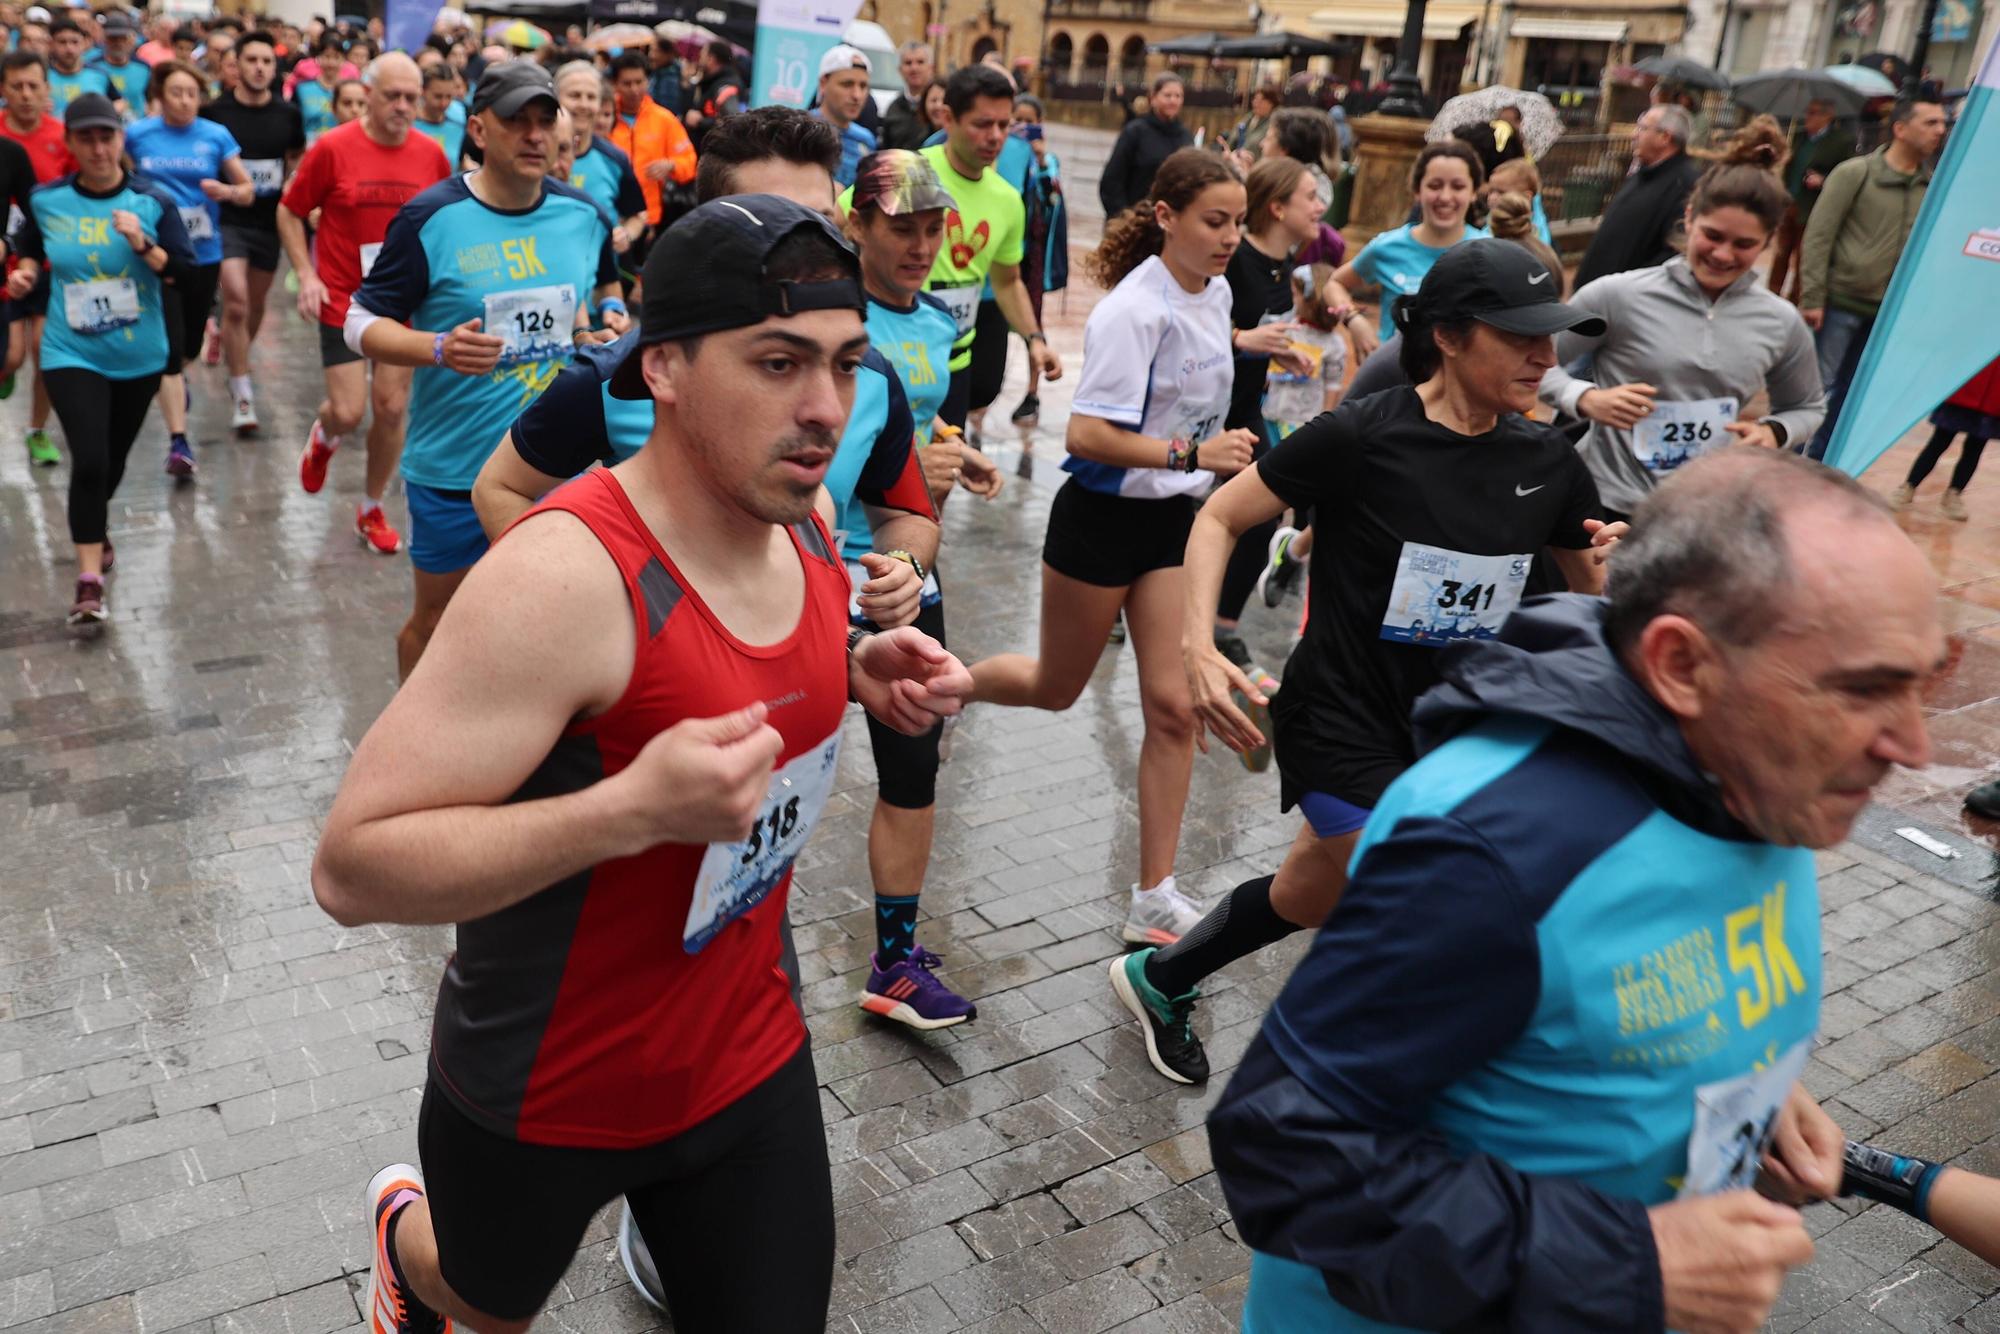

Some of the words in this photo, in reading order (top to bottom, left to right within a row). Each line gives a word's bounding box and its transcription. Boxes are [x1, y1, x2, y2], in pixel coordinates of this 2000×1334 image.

[80, 217, 110, 245] 5K
[502, 236, 547, 280] 5K
[515, 309, 554, 333] 126
[902, 340, 937, 385] 5K
[1663, 421, 1712, 442] 236
[1437, 579, 1496, 611] 341
[1725, 879, 1808, 1030] 5K
